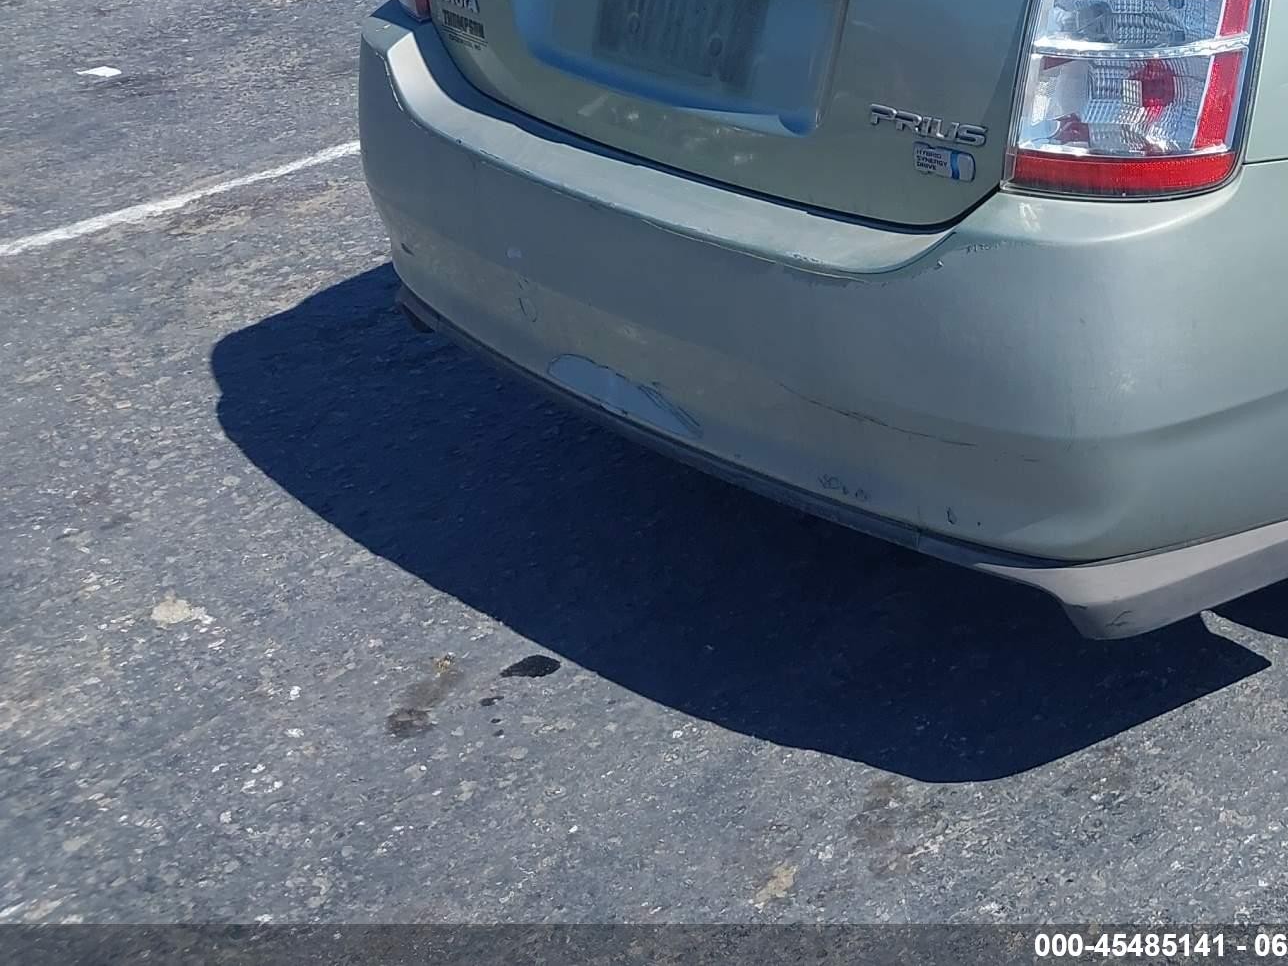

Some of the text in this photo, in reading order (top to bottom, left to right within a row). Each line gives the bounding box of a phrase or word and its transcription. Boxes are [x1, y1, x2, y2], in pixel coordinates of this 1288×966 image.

[869, 102, 988, 146] PRIUS
[916, 148, 942, 159] HYBRID
[916, 155, 948, 168] SYNERGY
[916, 161, 937, 171] DRIVE
